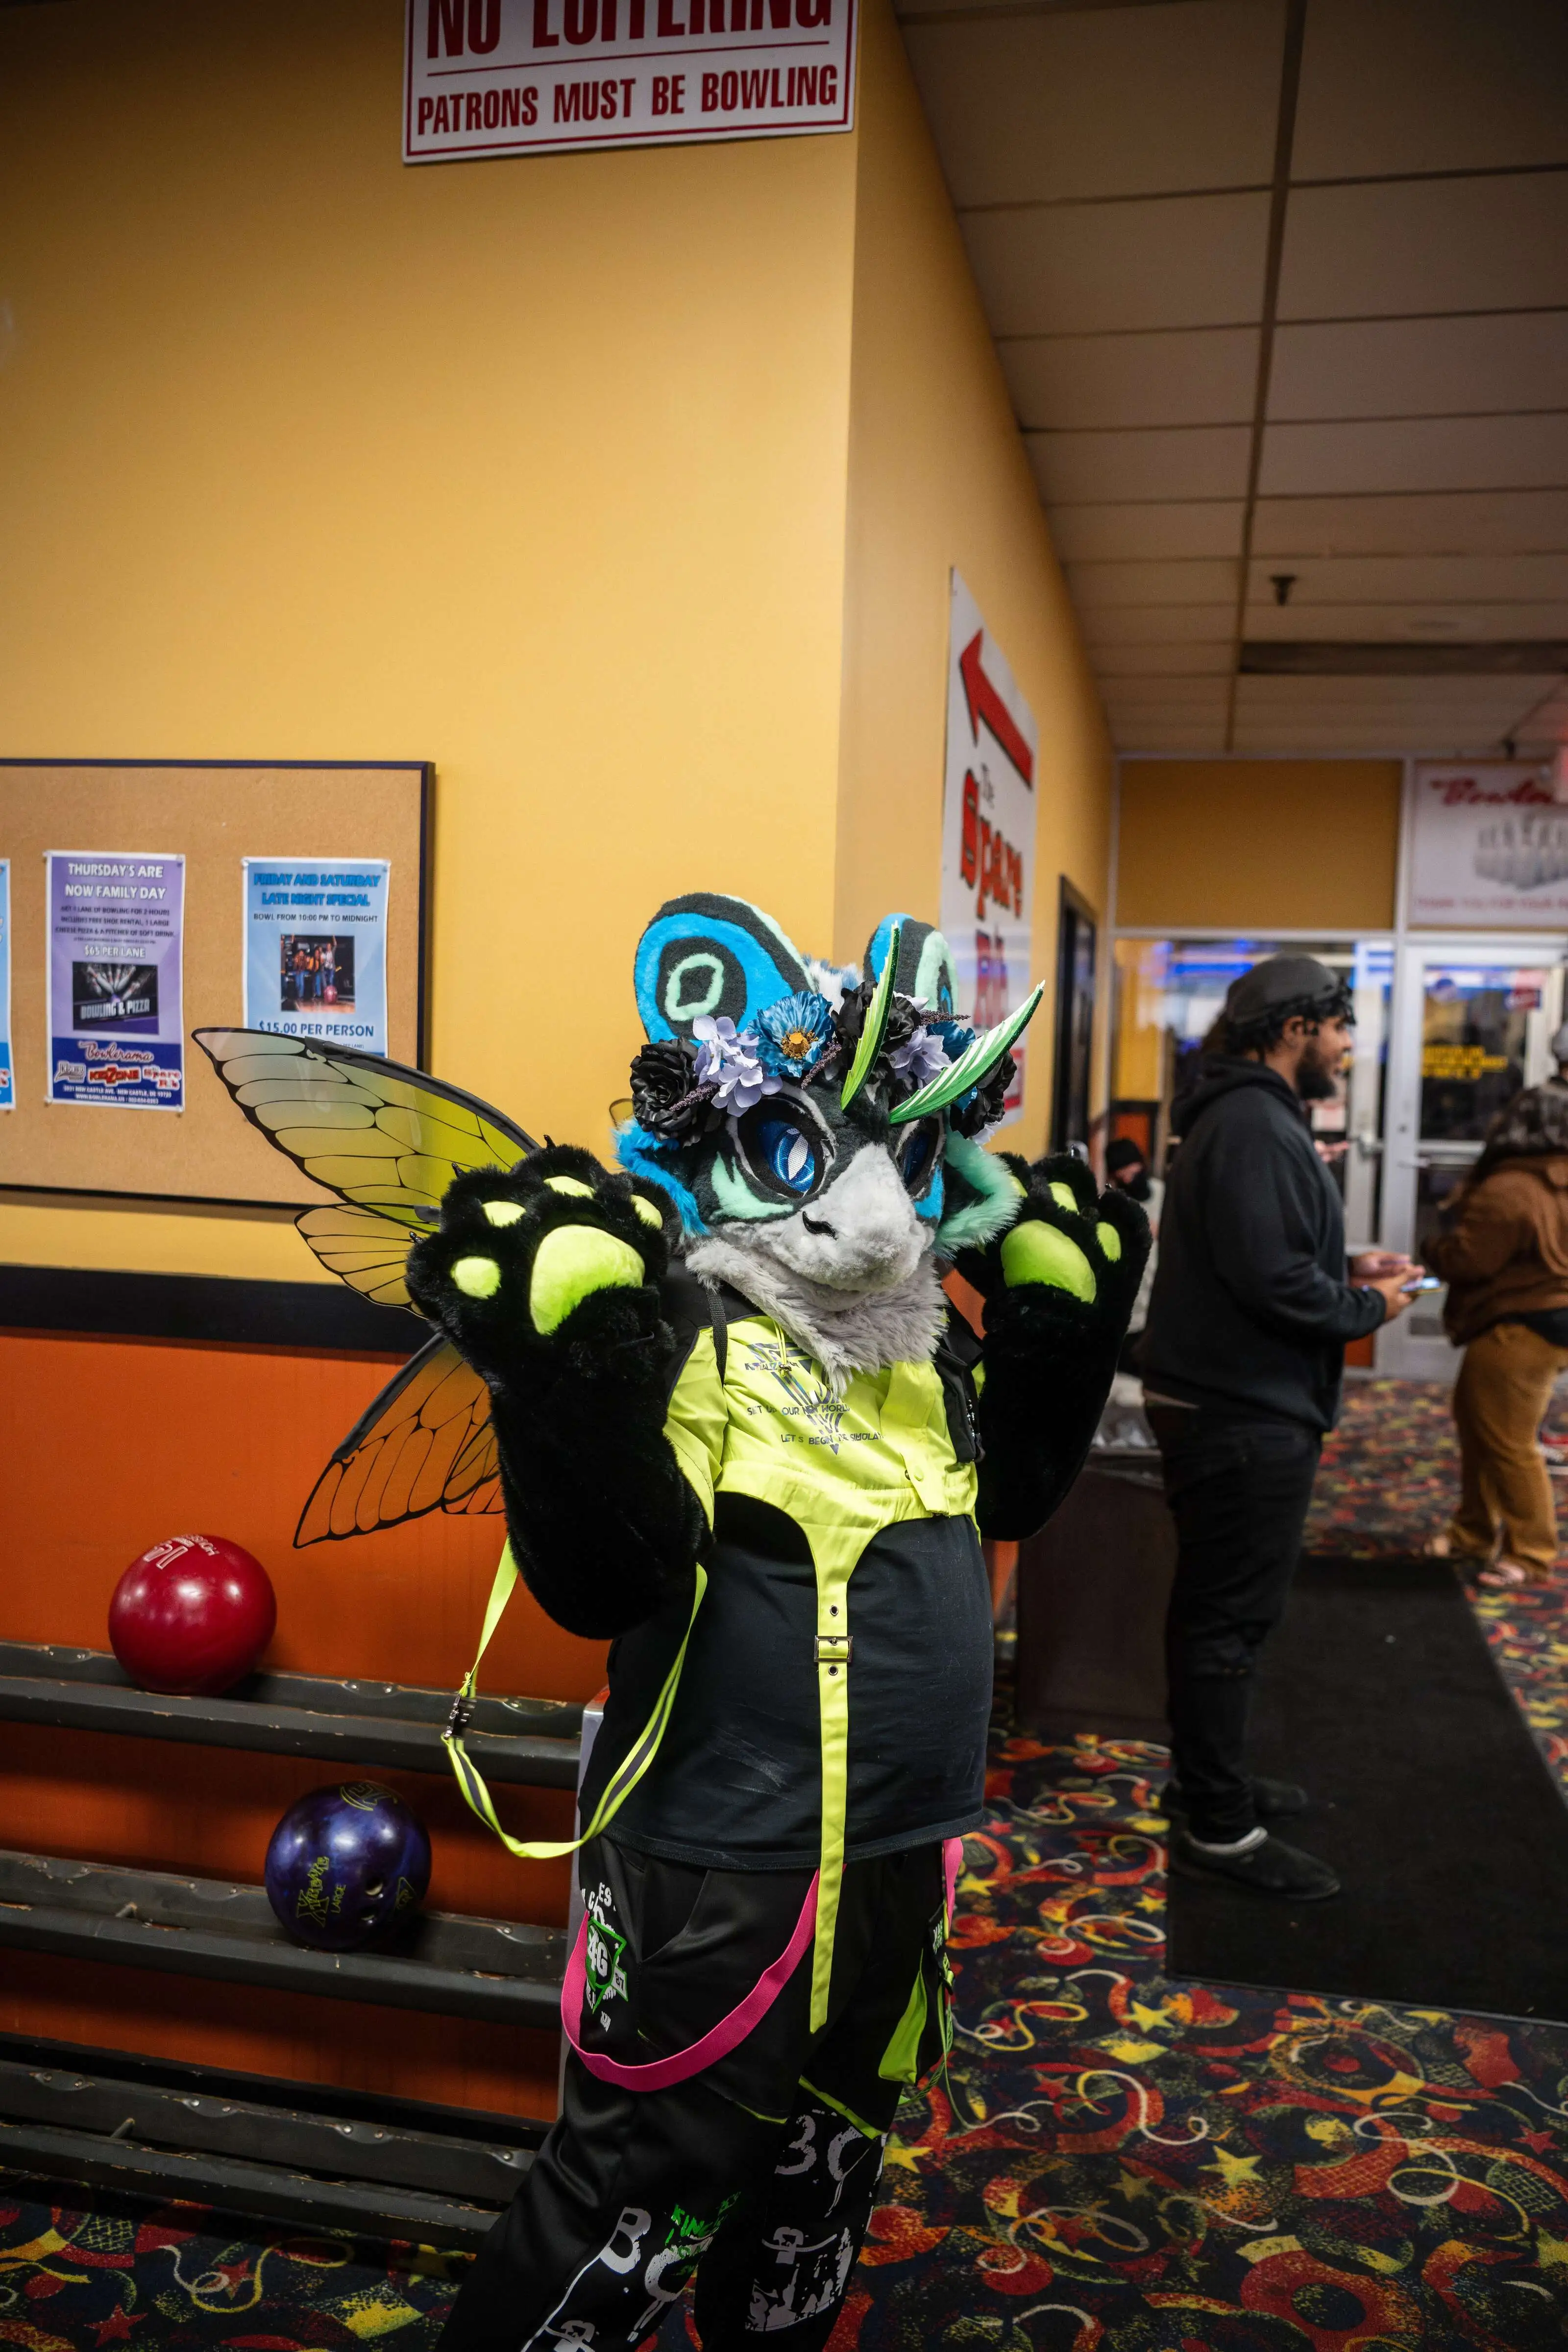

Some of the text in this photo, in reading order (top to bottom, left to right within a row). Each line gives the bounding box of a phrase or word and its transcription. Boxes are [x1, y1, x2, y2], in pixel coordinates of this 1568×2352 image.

[417, 64, 838, 136] PATRONS MUST BE BOWLING
[68, 862, 164, 878] THURSDAY'S ARE
[254, 873, 381, 887] FRIDAY AND SATURDAY
[65, 883, 166, 900] NOW FAMILY DAY
[262, 892, 370, 906] LATE NIGHT SPECIAL
[84, 944, 147, 958] $65 PER LANE
[80, 998, 150, 1020] BOWLING & PIZZA
[259, 1020, 375, 1037] $15.00 PER PERSON
[747, 1405, 762, 1416] SET
[782, 1407, 800, 1416] OUR
[808, 1435, 833, 1445] BEGIN
